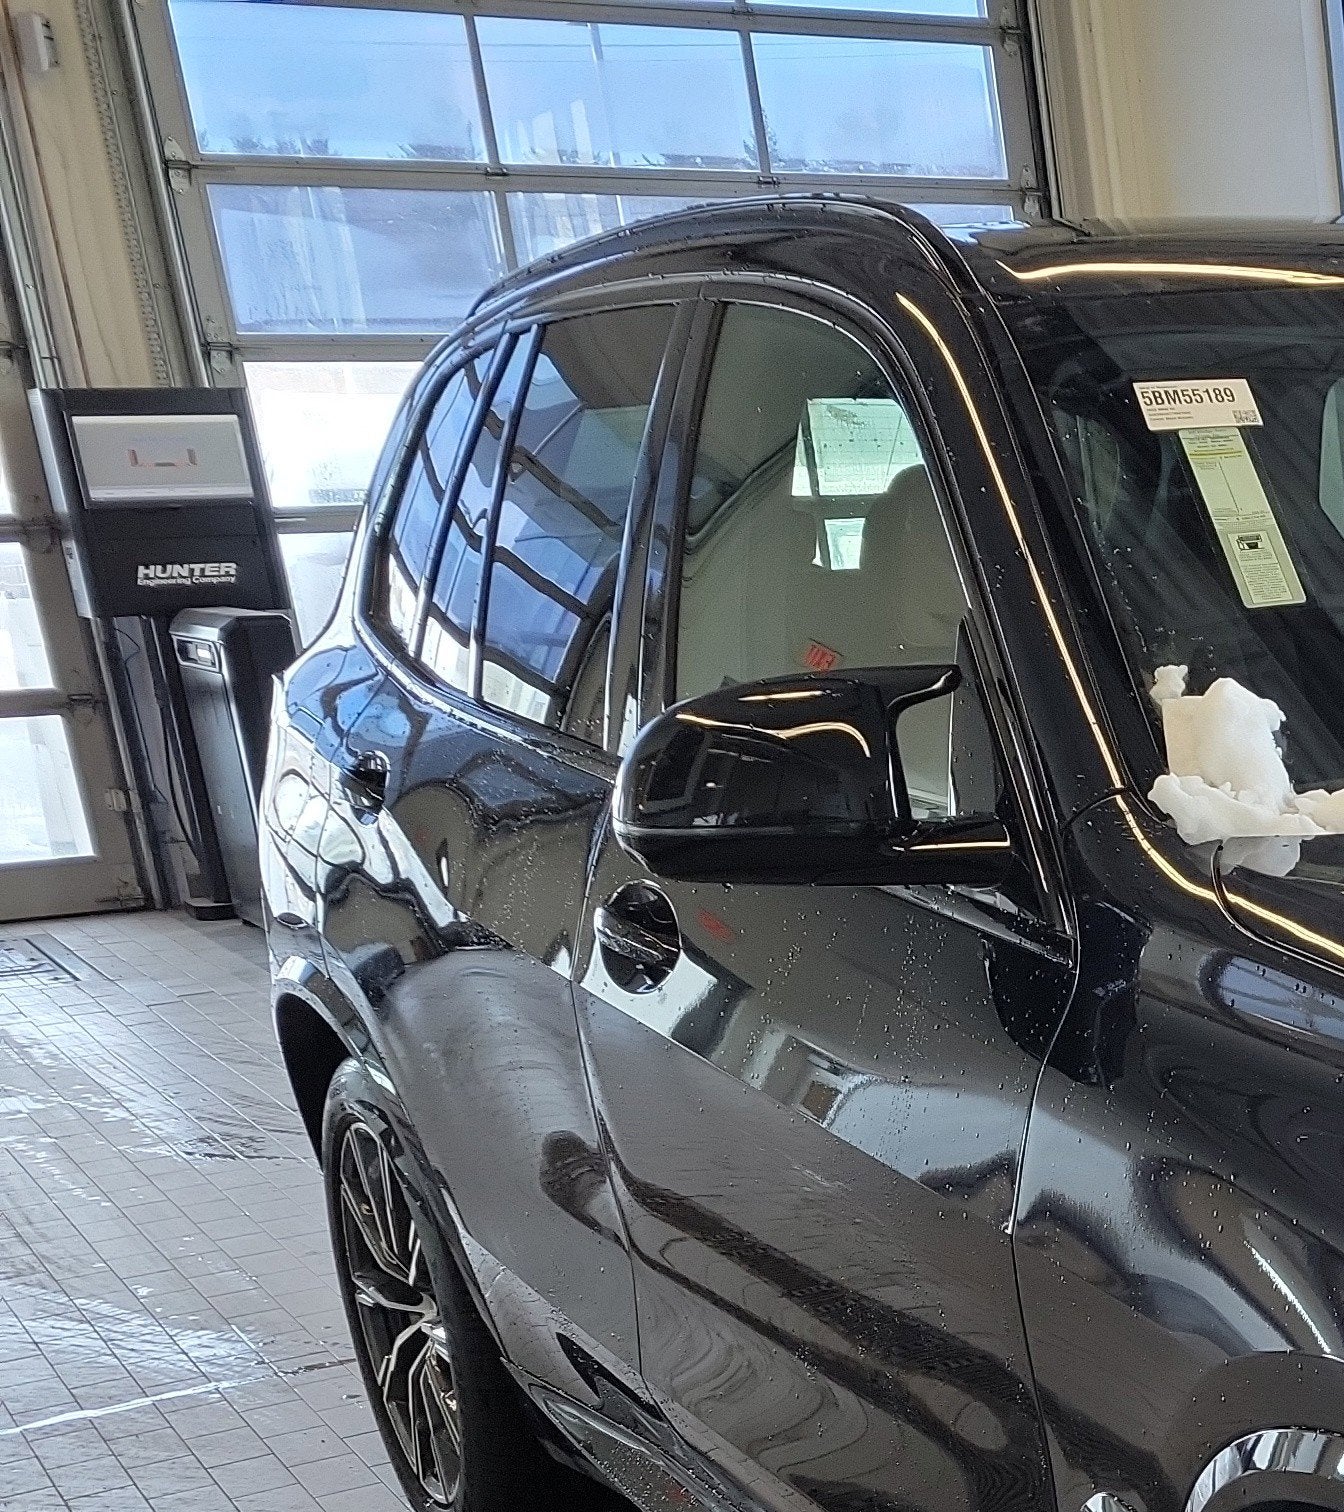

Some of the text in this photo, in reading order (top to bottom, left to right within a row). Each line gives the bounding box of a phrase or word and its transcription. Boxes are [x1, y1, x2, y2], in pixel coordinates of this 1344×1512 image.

[1140, 387, 1236, 406] 5BM55189
[137, 563, 237, 578] HUNTER
[137, 576, 236, 587] Engineering Company
